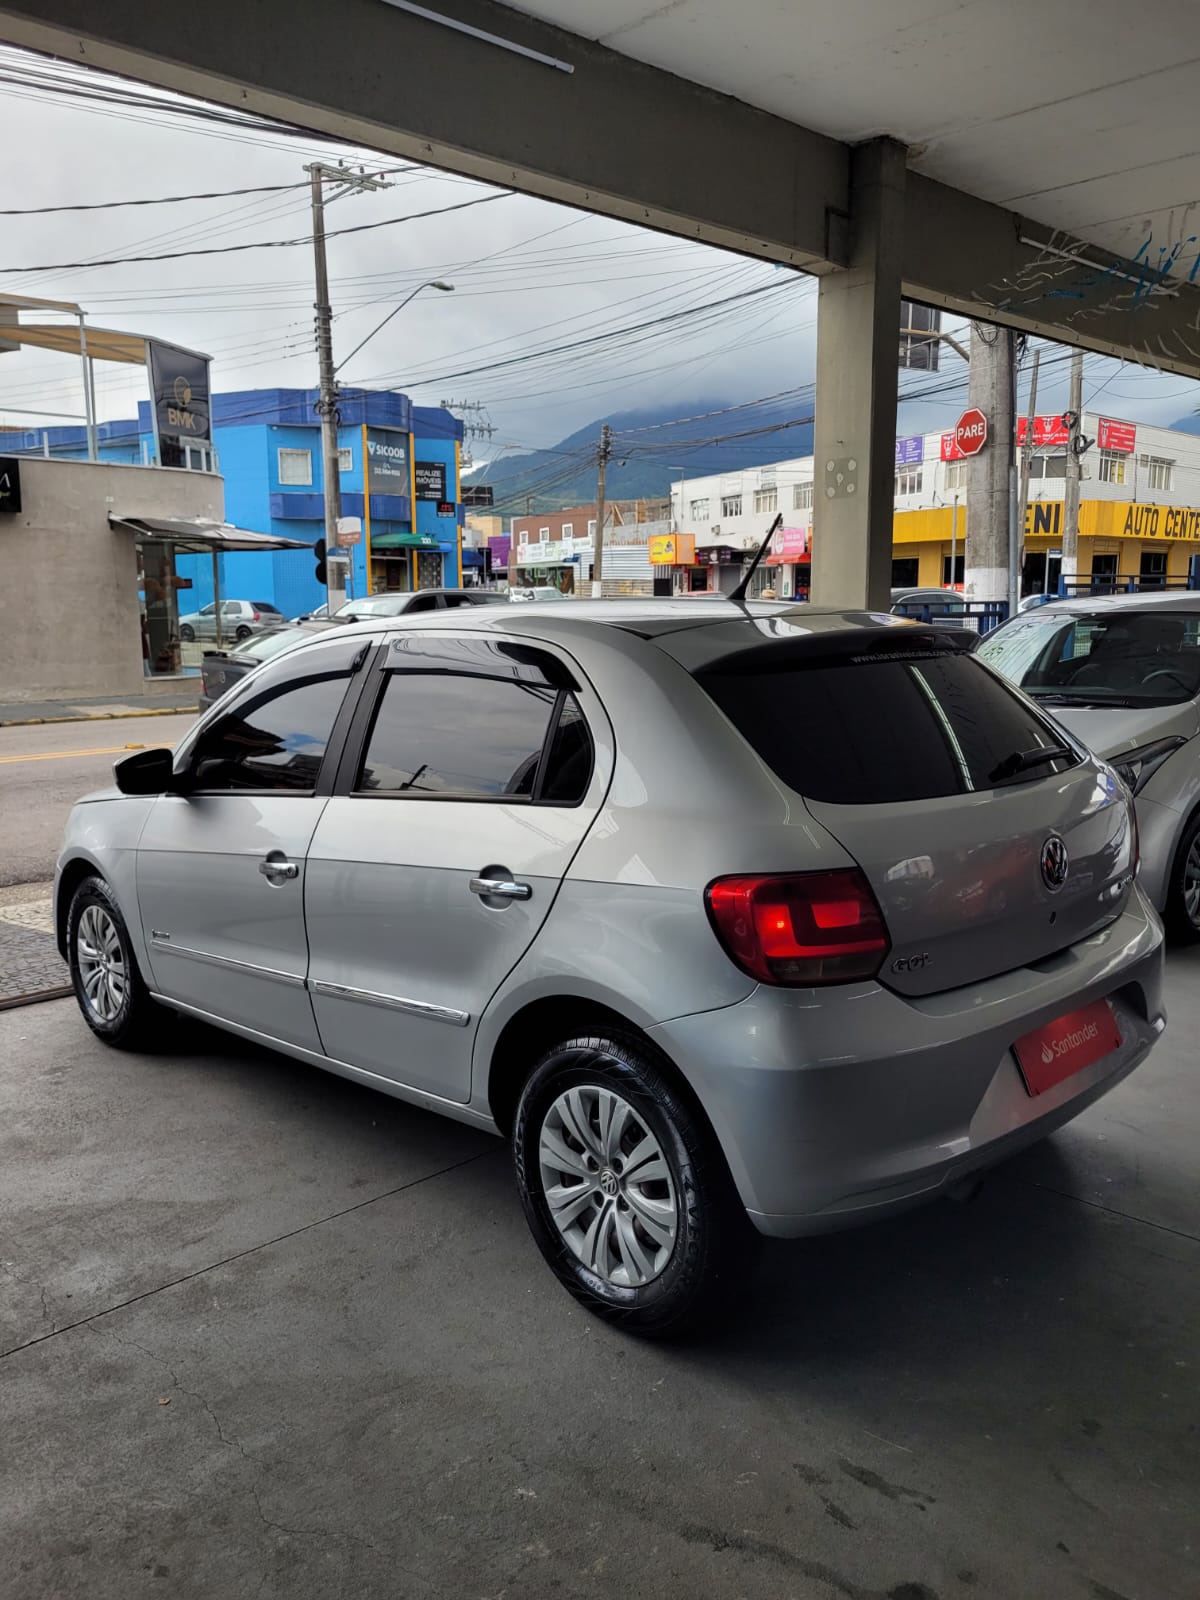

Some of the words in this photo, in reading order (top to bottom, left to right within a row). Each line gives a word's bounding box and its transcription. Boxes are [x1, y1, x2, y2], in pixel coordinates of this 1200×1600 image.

[168, 407, 197, 430] BMK
[957, 422, 985, 441] PARE
[376, 444, 405, 458] SICOOB
[1123, 505, 1159, 536] AUTO
[1051, 1022, 1099, 1057] Santander
